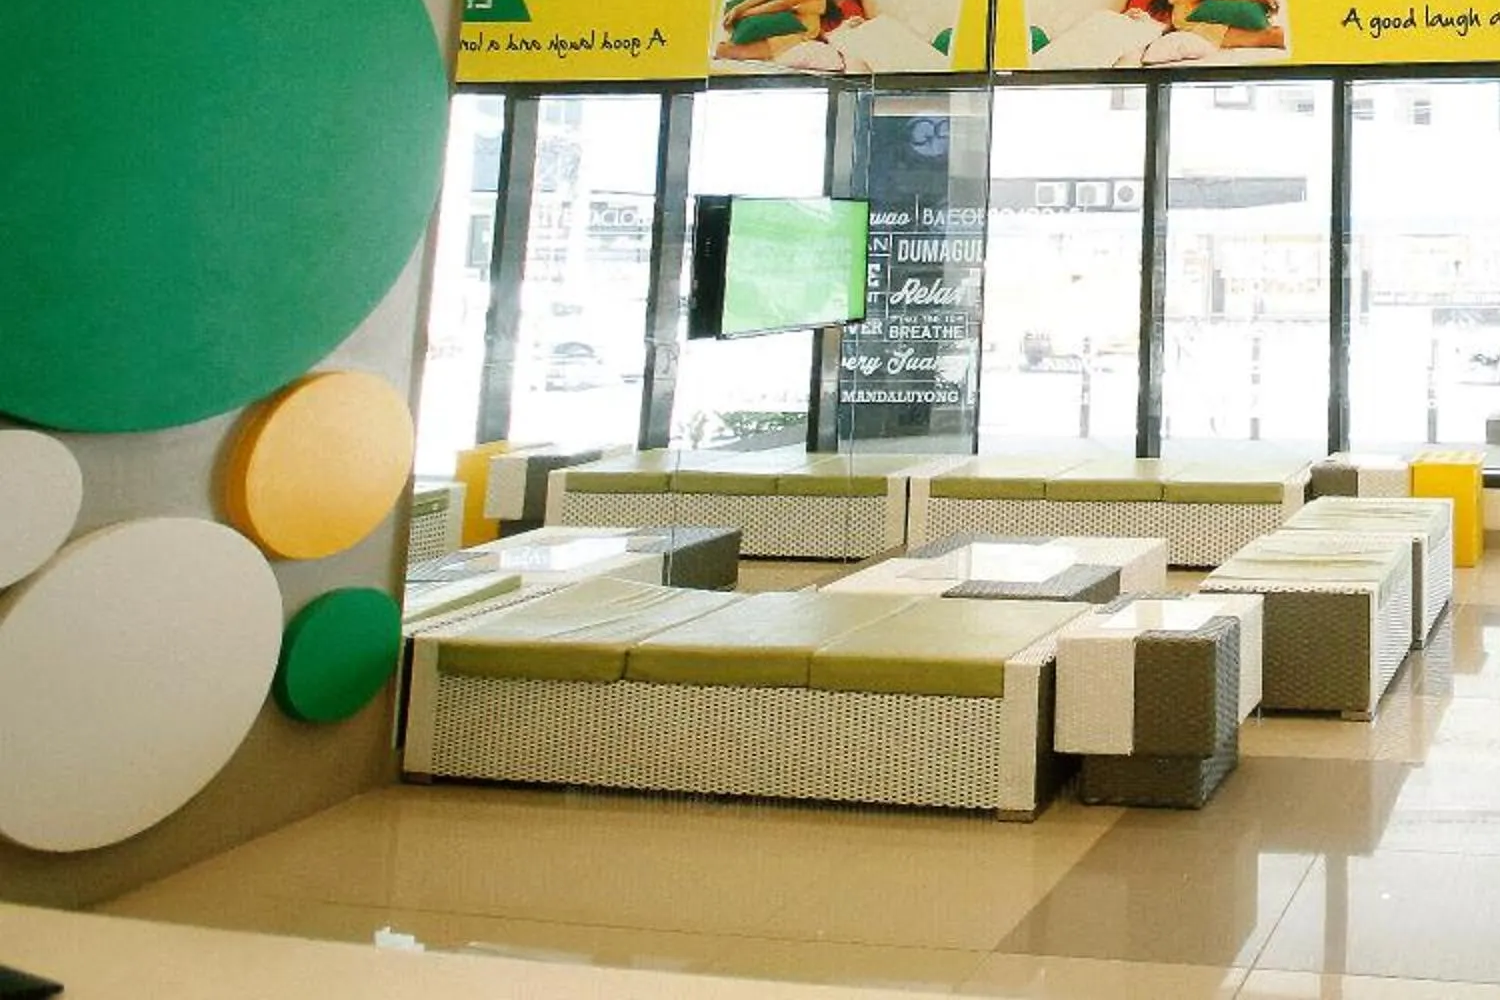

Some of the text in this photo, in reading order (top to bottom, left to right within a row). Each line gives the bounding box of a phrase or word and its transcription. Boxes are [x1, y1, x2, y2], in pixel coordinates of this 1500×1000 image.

[1342, 8, 1362, 30] A
[1369, 8, 1416, 38] good
[1425, 4, 1480, 36] laugh
[889, 325, 965, 339] BREATHE
[841, 390, 959, 403] MANDALUYONG
